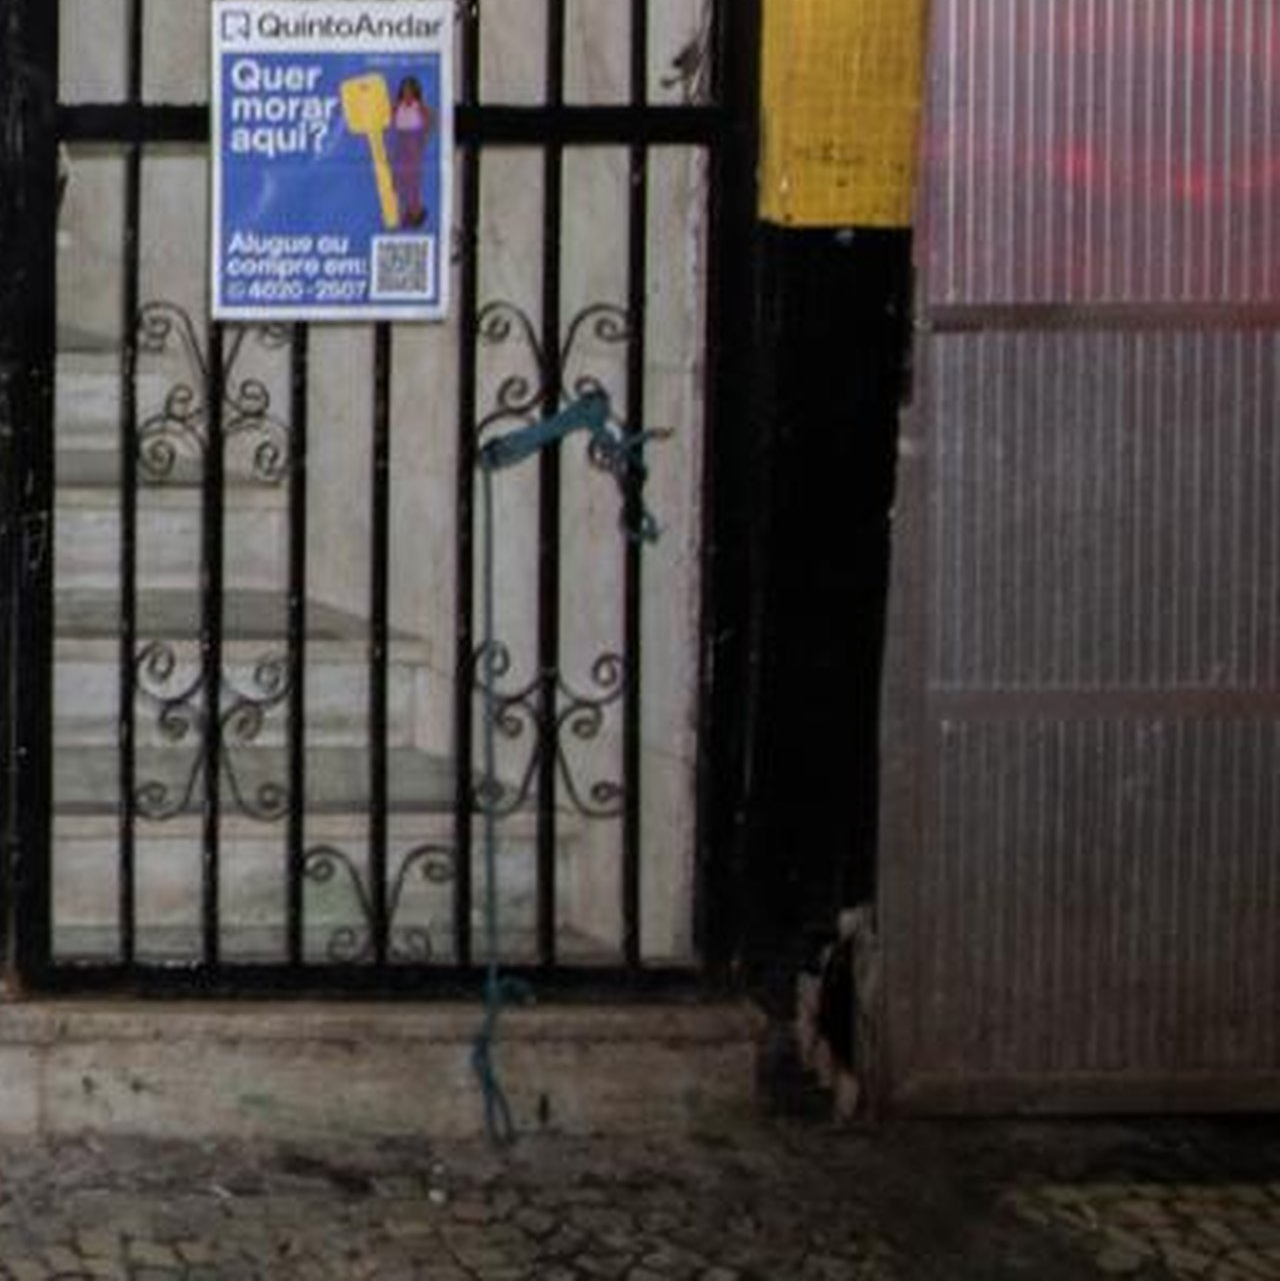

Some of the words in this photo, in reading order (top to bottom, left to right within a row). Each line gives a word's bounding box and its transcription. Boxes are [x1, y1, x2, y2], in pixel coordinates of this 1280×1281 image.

[258, 12, 441, 39] QuintoAndar
[231, 58, 322, 92] Quer
[231, 94, 338, 121] morar
[231, 121, 328, 158] aqui?
[316, 234, 349, 255] ou
